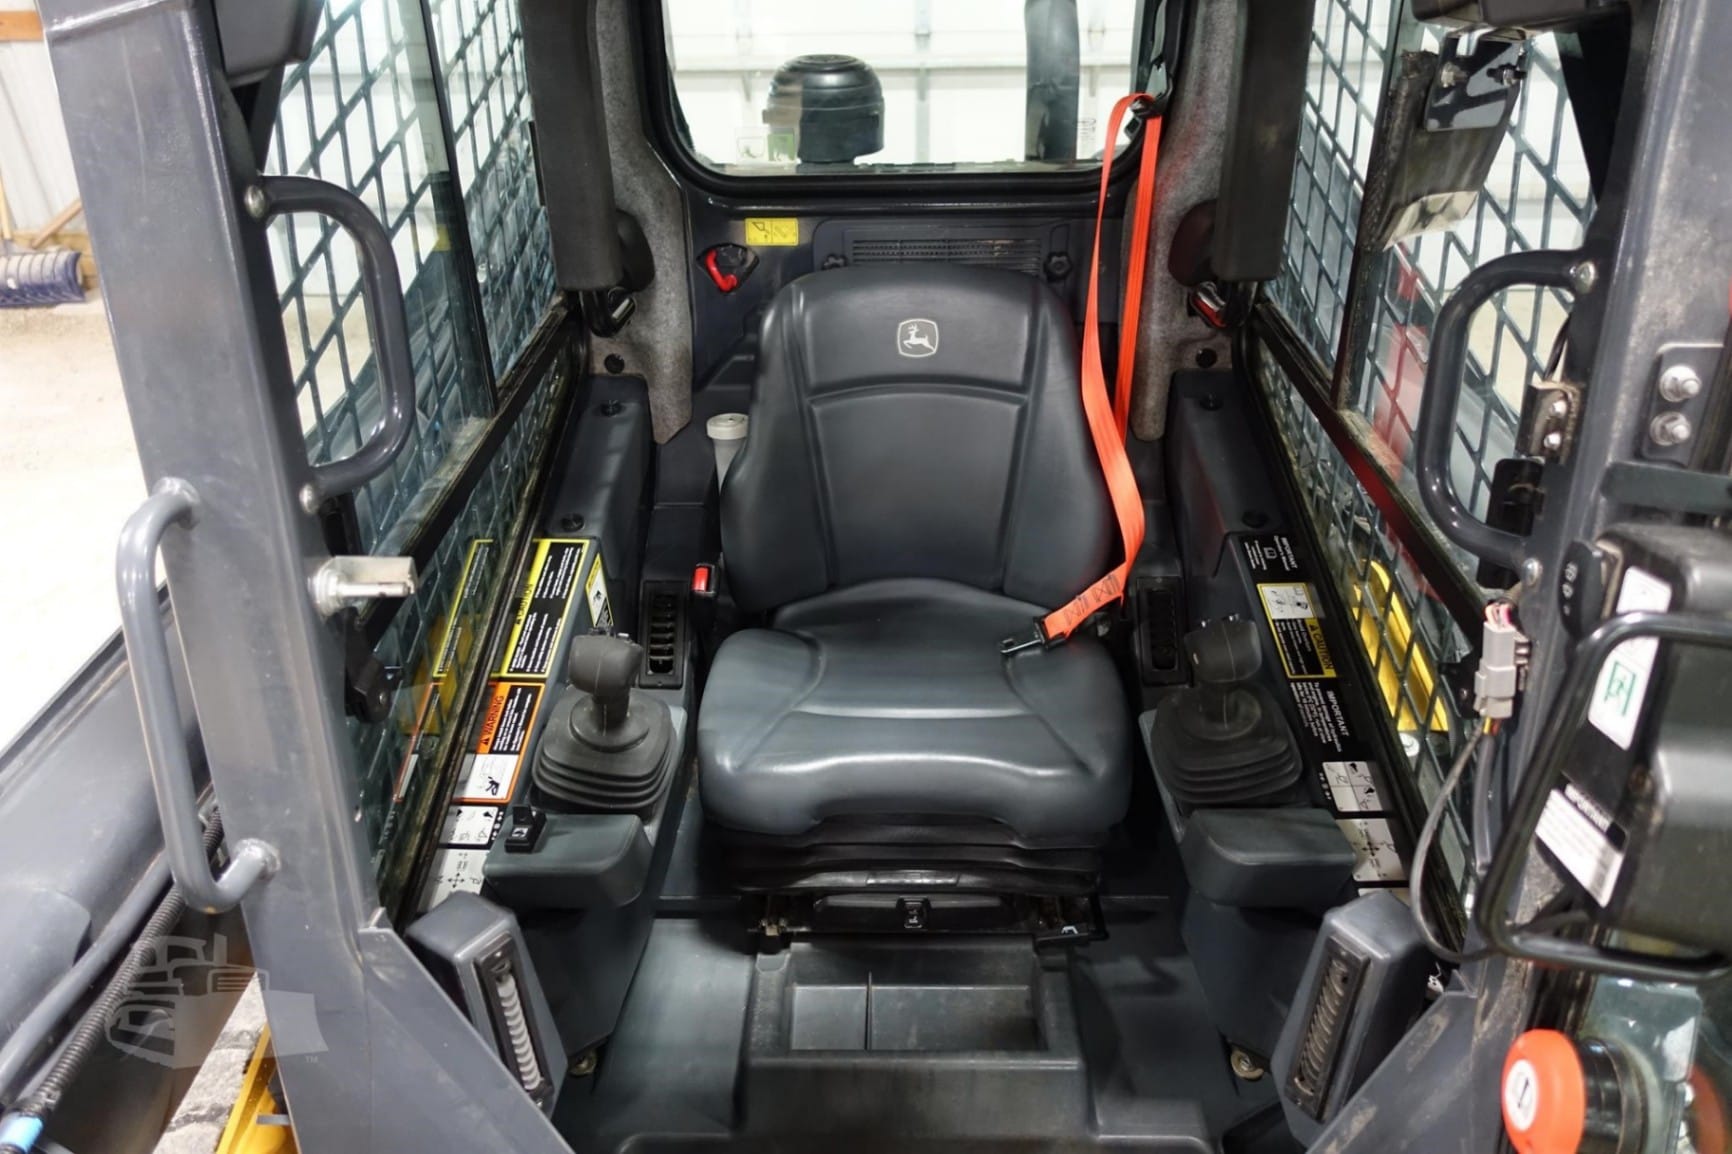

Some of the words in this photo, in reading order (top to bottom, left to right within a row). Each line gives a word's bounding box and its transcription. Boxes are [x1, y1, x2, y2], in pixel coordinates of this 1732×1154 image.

[1313, 633, 1334, 670] CAUTION
[483, 695, 504, 735] WARNING
[1326, 690, 1350, 737] IMPORTANT
